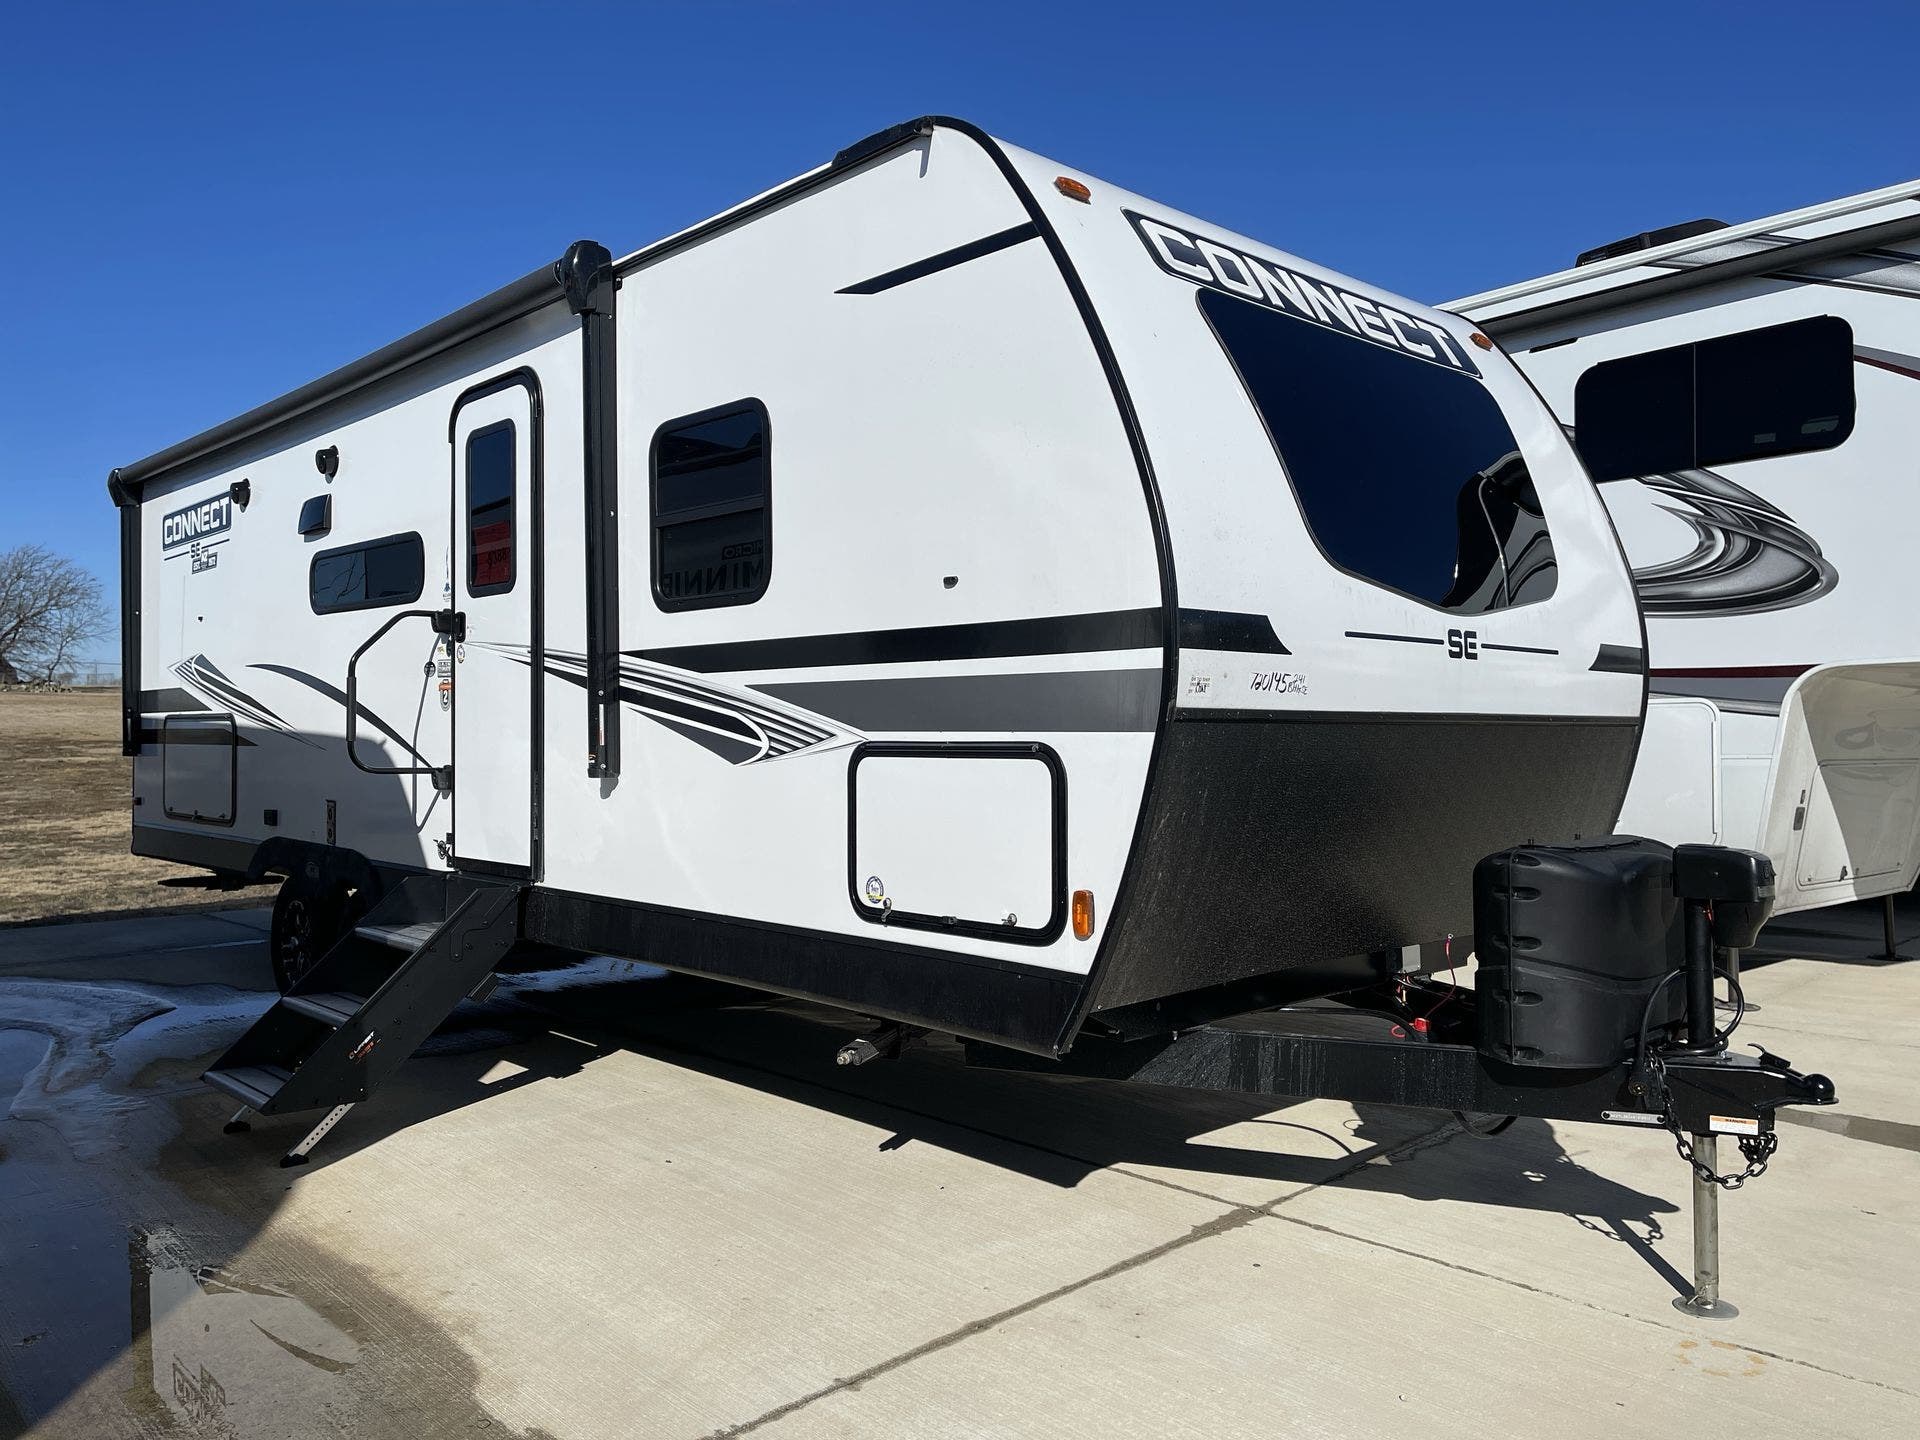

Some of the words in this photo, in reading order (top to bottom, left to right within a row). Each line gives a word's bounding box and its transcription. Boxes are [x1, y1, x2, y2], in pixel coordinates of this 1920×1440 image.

[1139, 218, 1463, 368] CONNECT
[164, 496, 230, 545] CONNECT
[190, 542, 201, 559] SE
[1447, 628, 1478, 660] SE
[1250, 671, 1292, 693] 720145
